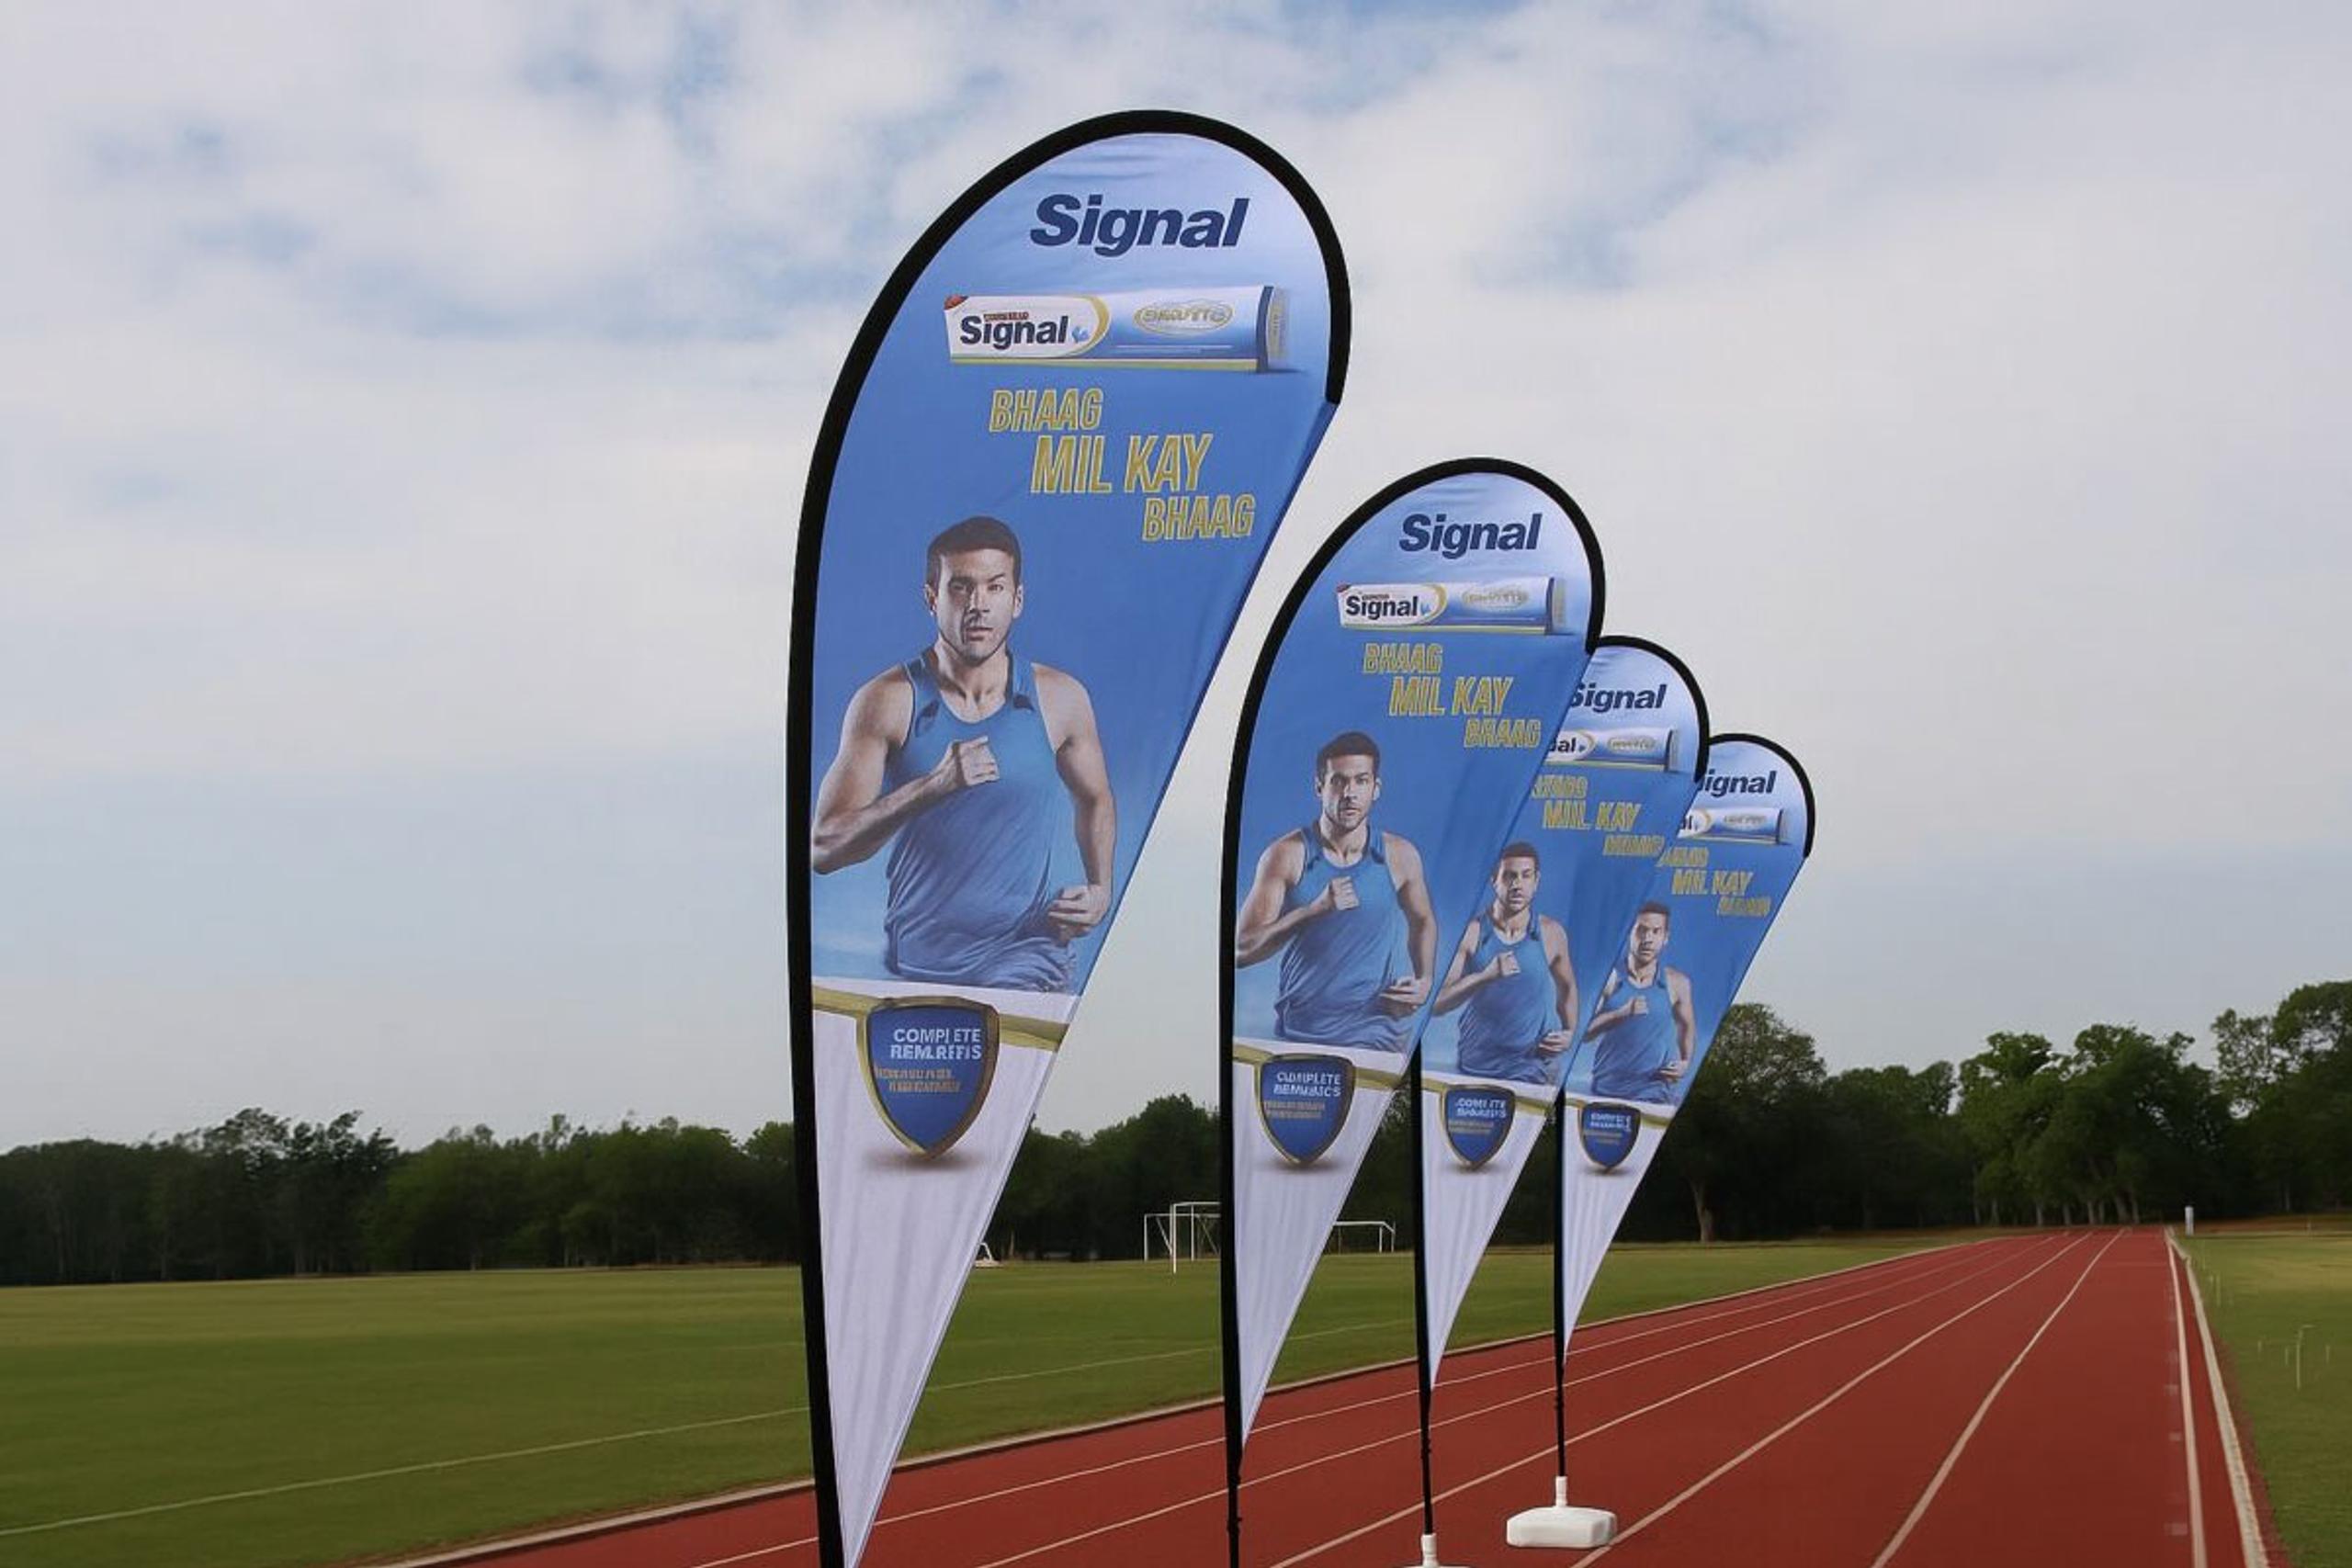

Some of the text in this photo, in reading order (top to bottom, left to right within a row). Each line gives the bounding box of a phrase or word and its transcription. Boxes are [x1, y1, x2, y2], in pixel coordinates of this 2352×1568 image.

[1029, 194, 1250, 257] Signal
[959, 315, 1069, 351] Signal
[989, 388, 1104, 433] BHAAG
[1030, 433, 1214, 494] MIL KAY
[1142, 493, 1256, 541] BHAAG
[1398, 513, 1543, 559] Signal
[1345, 595, 1419, 619] Signal
[1388, 675, 1514, 716] MIL KAY
[1699, 768, 1778, 798] ignal
